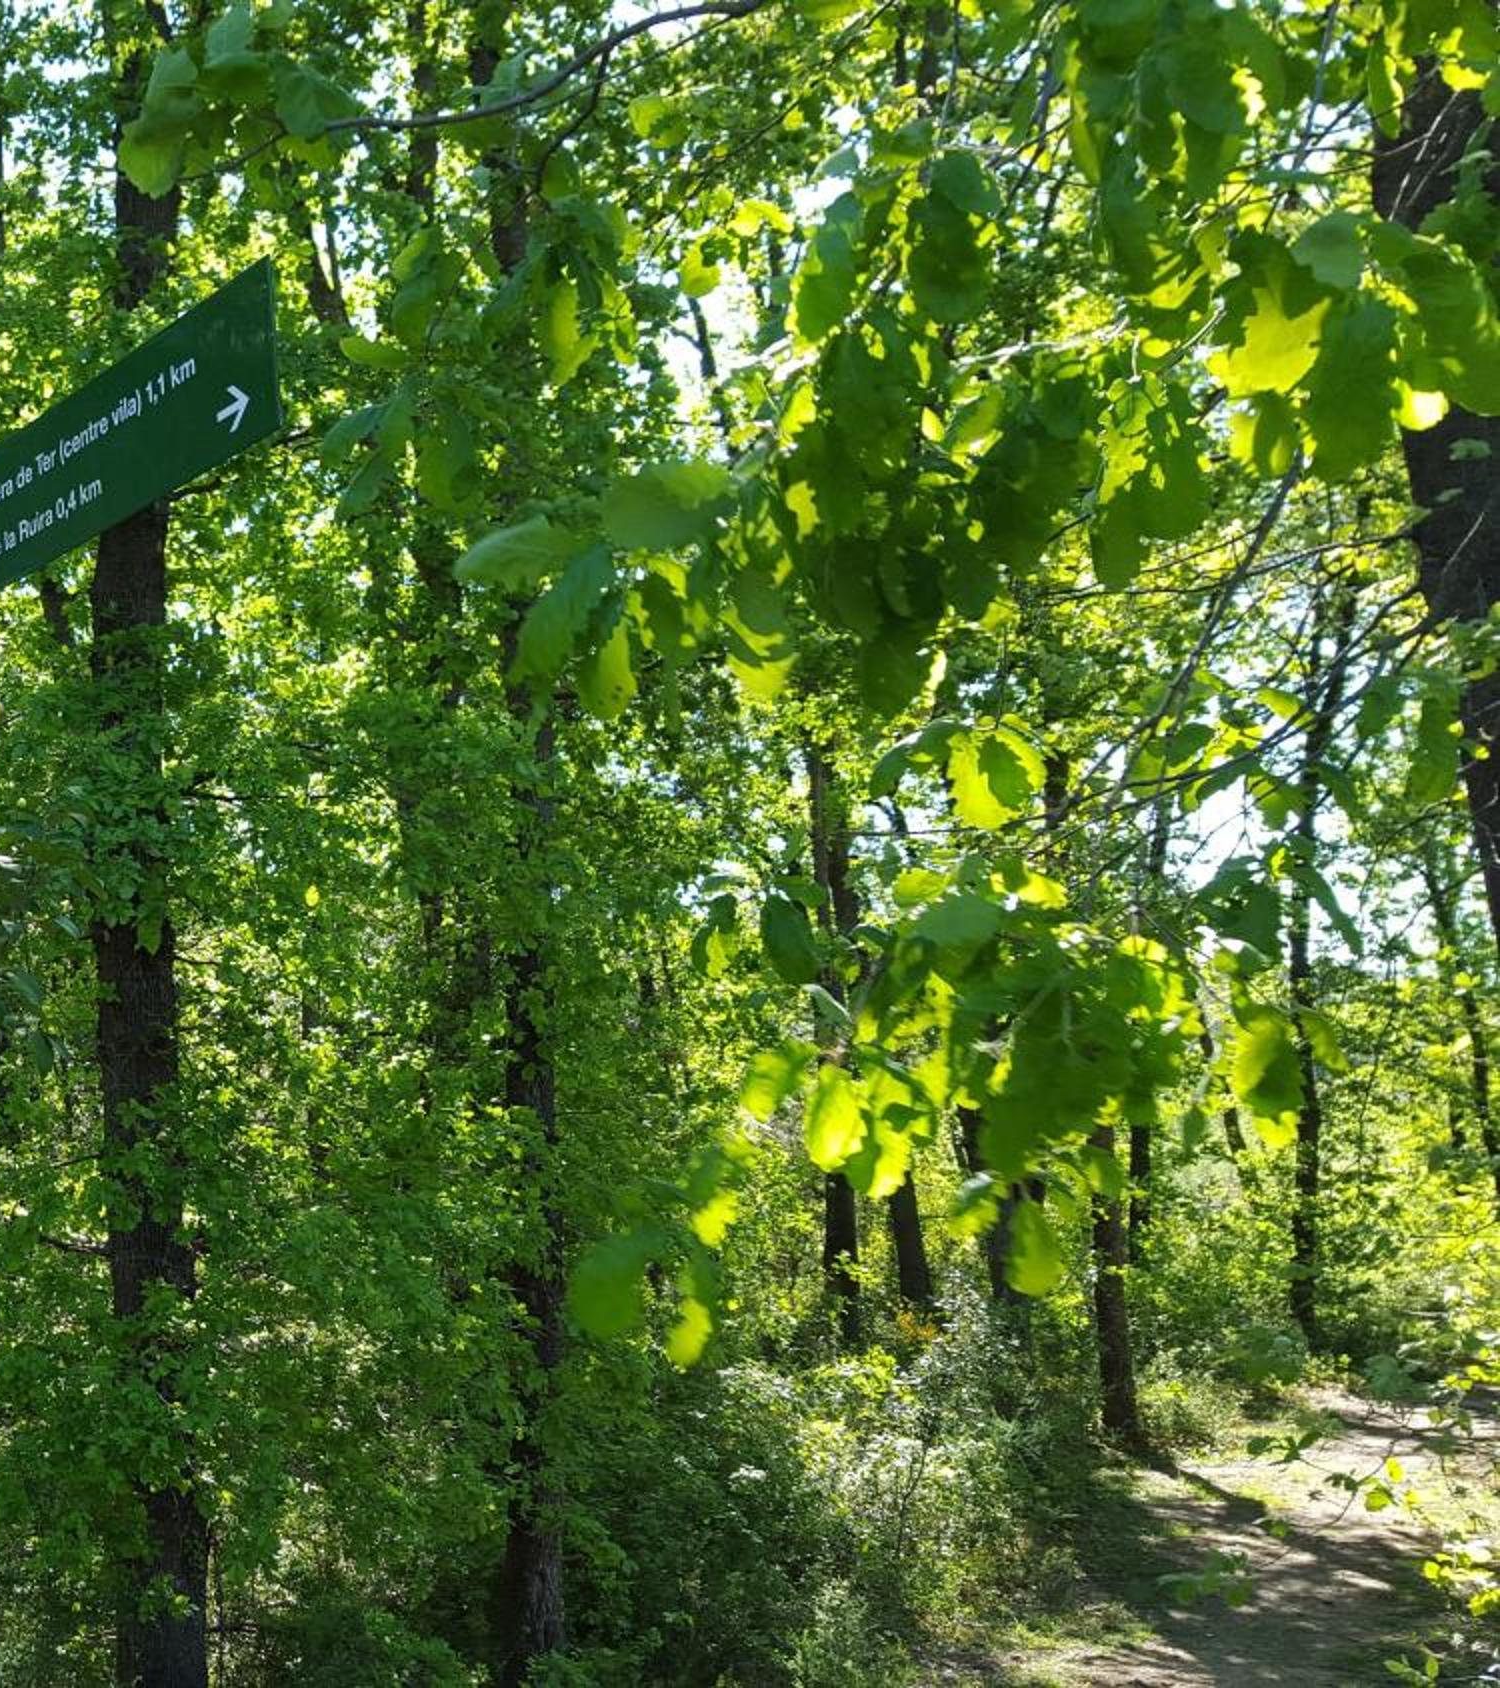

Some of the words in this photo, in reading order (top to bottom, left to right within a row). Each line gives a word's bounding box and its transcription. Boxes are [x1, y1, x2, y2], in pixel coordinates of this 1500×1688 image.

[15, 462, 33, 489] de
[35, 450, 56, 474] Ter
[59, 415, 109, 465] (centre
[111, 389, 142, 427] vila)
[146, 374, 167, 405] 1,1
[170, 358, 196, 387] km
[3, 531, 17, 553] la
[19, 506, 53, 543] Ruira
[55, 491, 77, 519] 0,4
[78, 479, 103, 507] km
